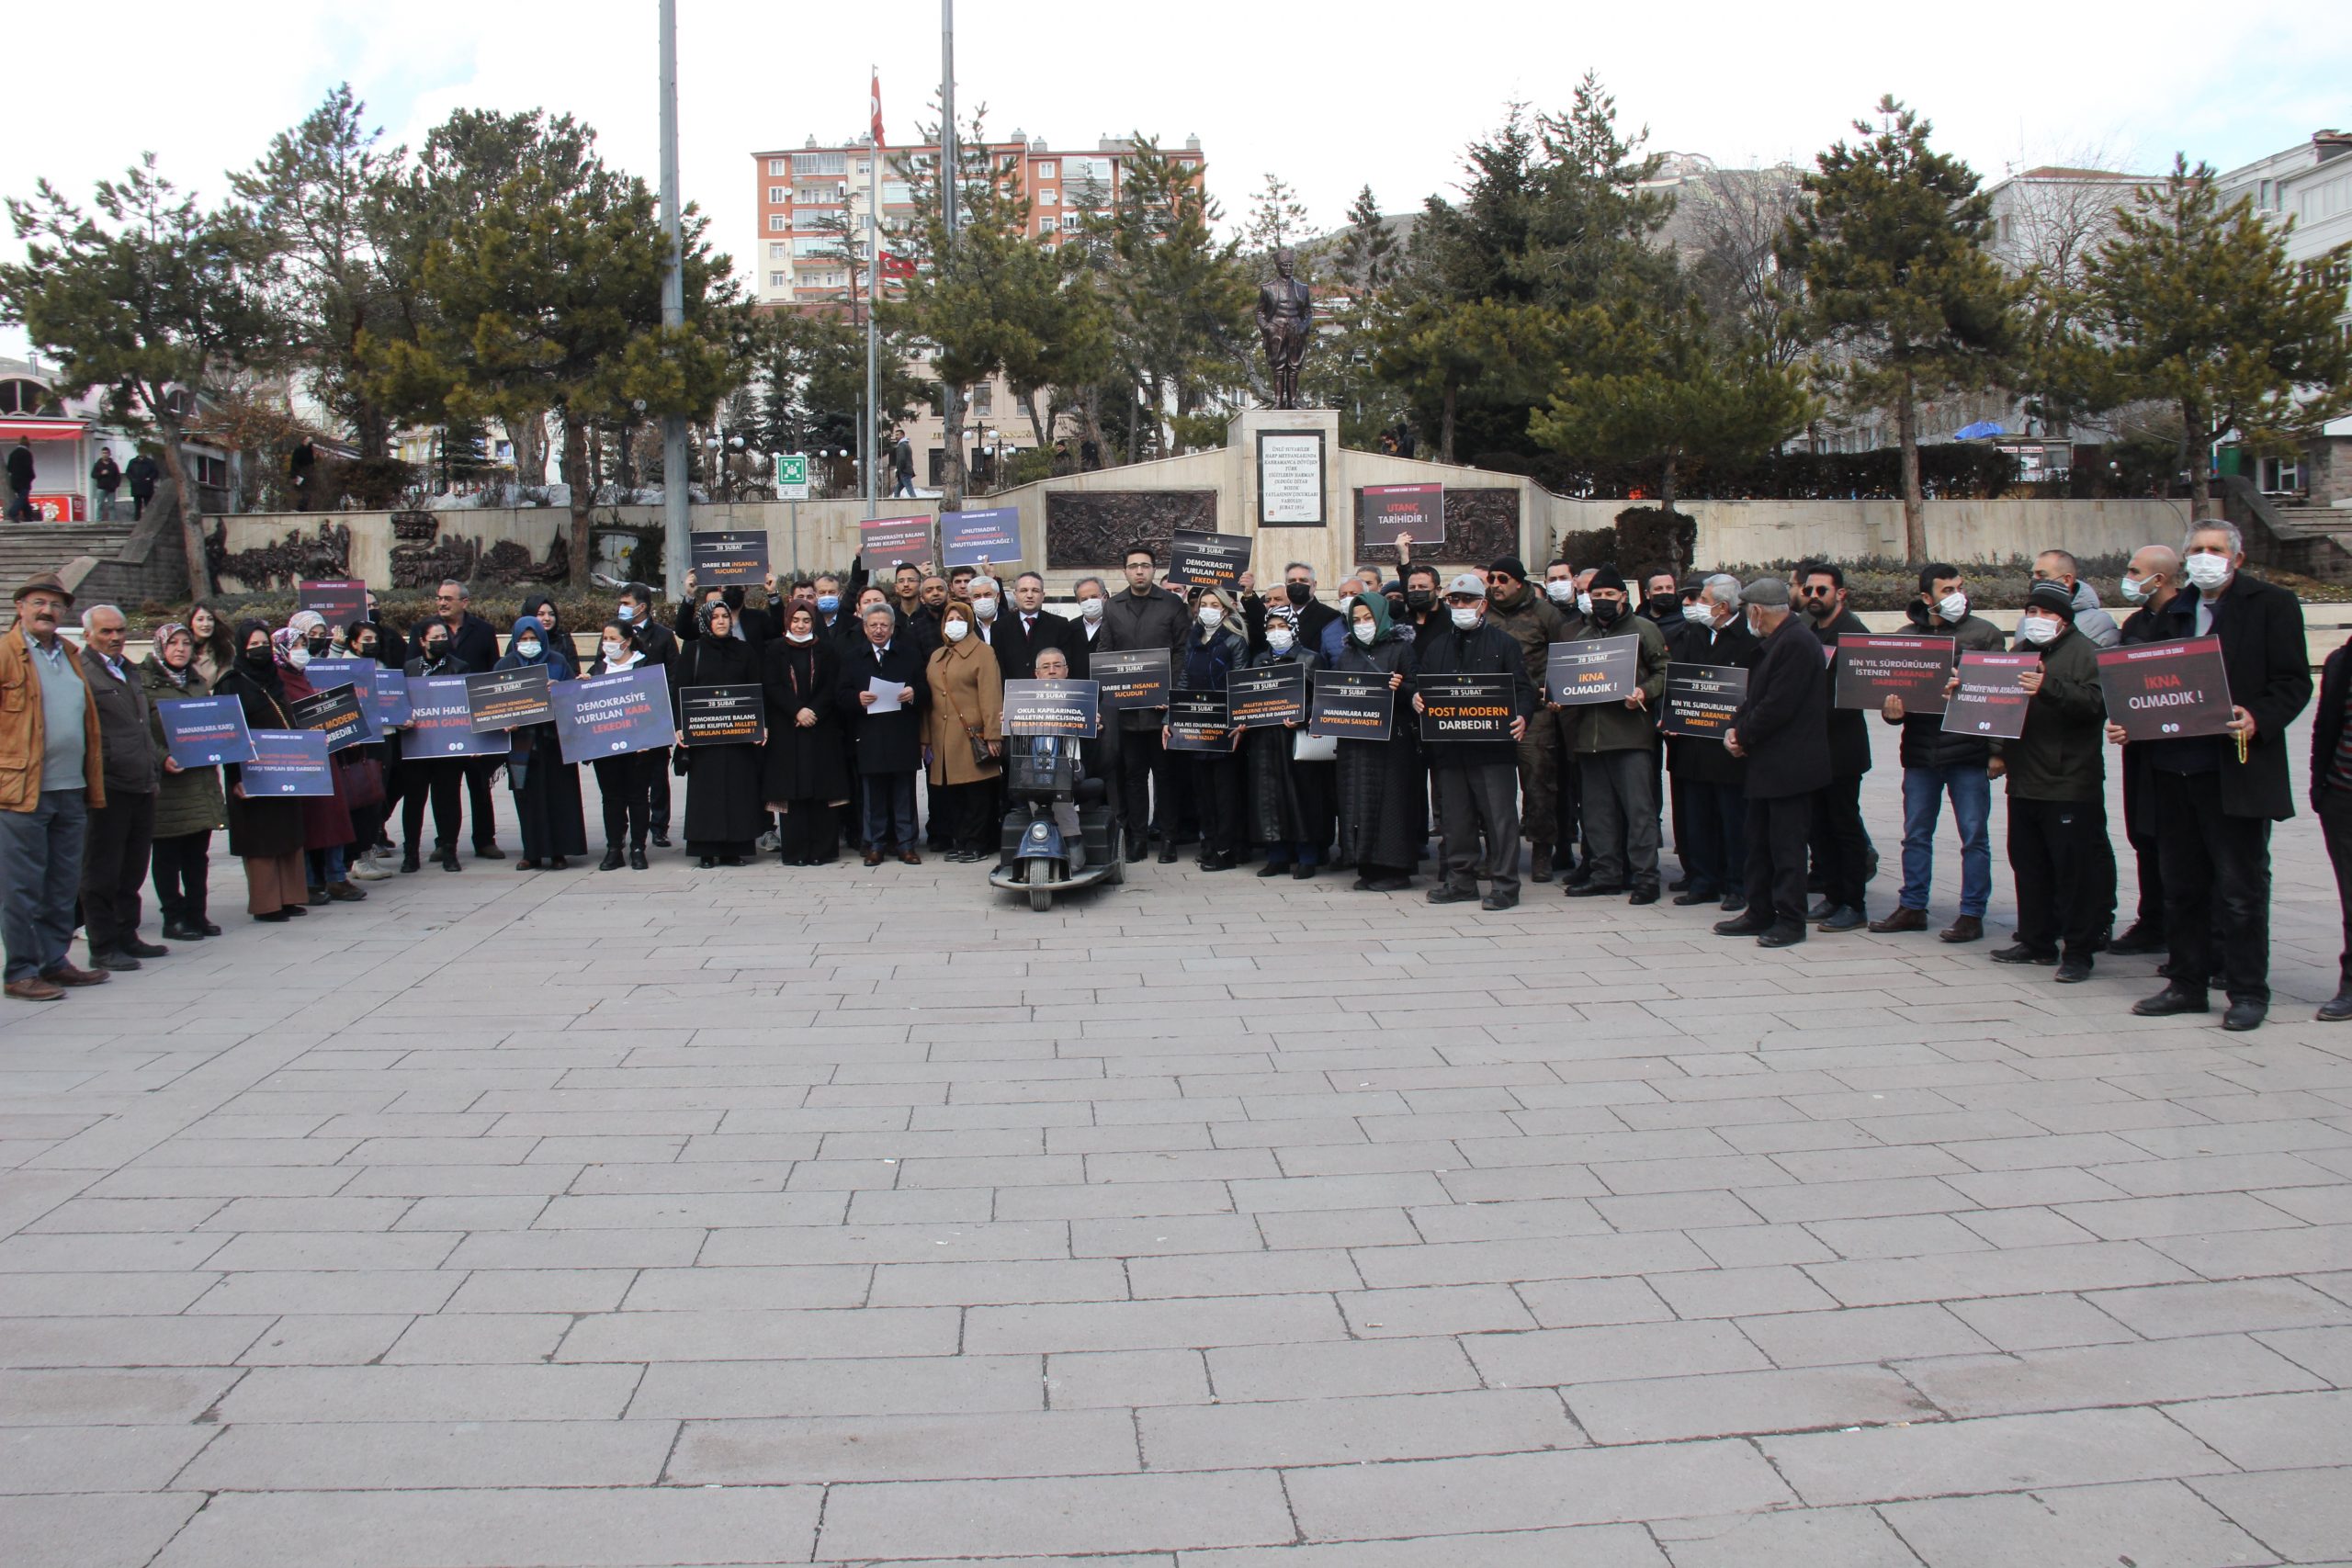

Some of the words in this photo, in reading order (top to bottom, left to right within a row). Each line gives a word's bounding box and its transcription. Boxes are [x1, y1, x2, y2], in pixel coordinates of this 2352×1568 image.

[1386, 502, 1419, 513] UTANÇ
[1378, 513, 1422, 524] TARİHİDİR
[868, 533, 904, 541] DEMOKRASİYE
[950, 538, 1010, 548] UNUTTURMAYACAĞIZ
[1186, 558, 1233, 570] DEMOKRASİYE
[1182, 567, 1215, 576] VURULAN
[1216, 570, 1234, 579] KARA
[1191, 576, 1218, 585] LEKEDİR
[1849, 657, 1863, 666] BİN
[1879, 659, 1941, 669] SÜRDÜRÜLMEK
[1578, 672, 1605, 682] İKNA
[1855, 667, 1890, 677] İSTENEN
[2144, 674, 2182, 689] İKNA
[1563, 683, 1611, 696] OLMADIK
[1961, 683, 1999, 693] TÜRKİYE'NİN
[577, 692, 646, 712] DEMOKRASİYE
[1957, 694, 1987, 703] VURULAN
[2128, 691, 2195, 709] OLMADIK
[412, 707, 440, 717] NSAN
[575, 709, 623, 724] VURULAN
[625, 704, 651, 716] KARA
[1037, 708, 1083, 716] KAPILARINDA,
[1323, 709, 1362, 717] İNANANLARA
[1428, 707, 1456, 716] POST
[1459, 706, 1509, 716] MODERN
[1675, 708, 1700, 717] İSTENEN
[1701, 711, 1731, 721] KARANLIK
[325, 711, 359, 730] MODERN
[1439, 720, 1493, 730] DARBEDİR
[1685, 718, 1715, 727] DARBEDİR
[593, 719, 632, 734] LEKEDİR
[327, 726, 353, 743] RBEDİR
